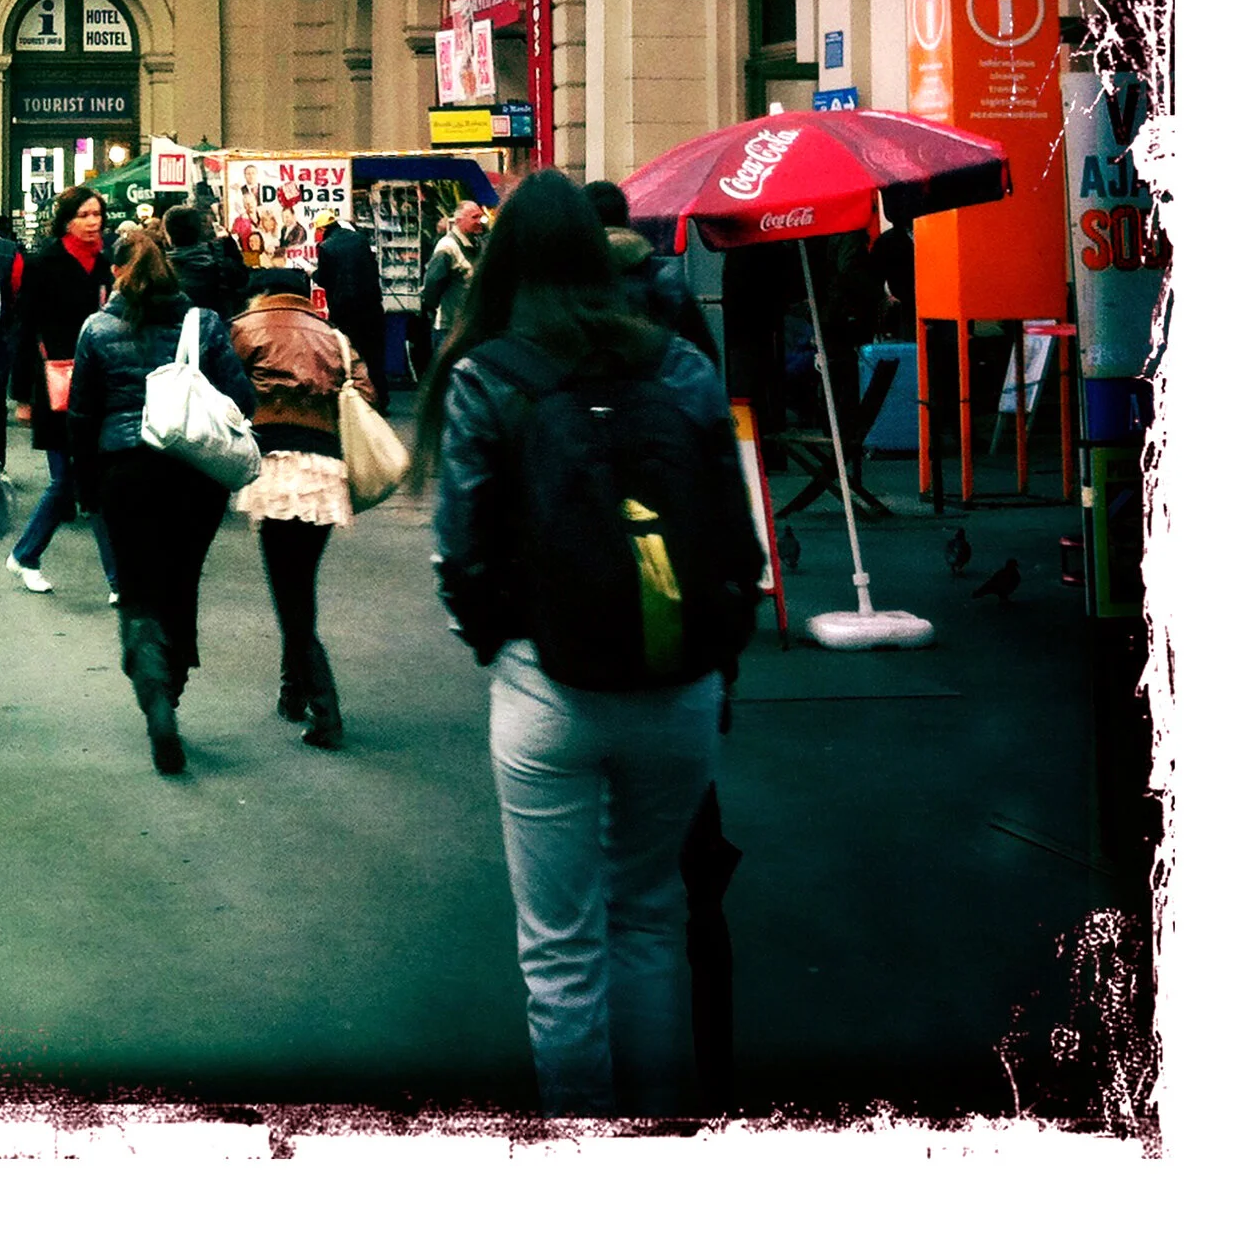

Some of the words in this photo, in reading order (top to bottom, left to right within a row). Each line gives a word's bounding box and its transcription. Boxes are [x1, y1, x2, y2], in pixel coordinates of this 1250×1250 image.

[86, 9, 121, 24] HOTEL
[18, 37, 46, 45] TOURIST
[48, 37, 63, 45] INFO
[86, 31, 128, 46] HOSTEL
[23, 97, 85, 112] TOURIST
[90, 97, 125, 112] INFO
[718, 129, 802, 200] Coca-Cola
[279, 164, 347, 187] Nagy
[261, 182, 346, 203] Dbás
[759, 206, 816, 232] Coca-Cola
